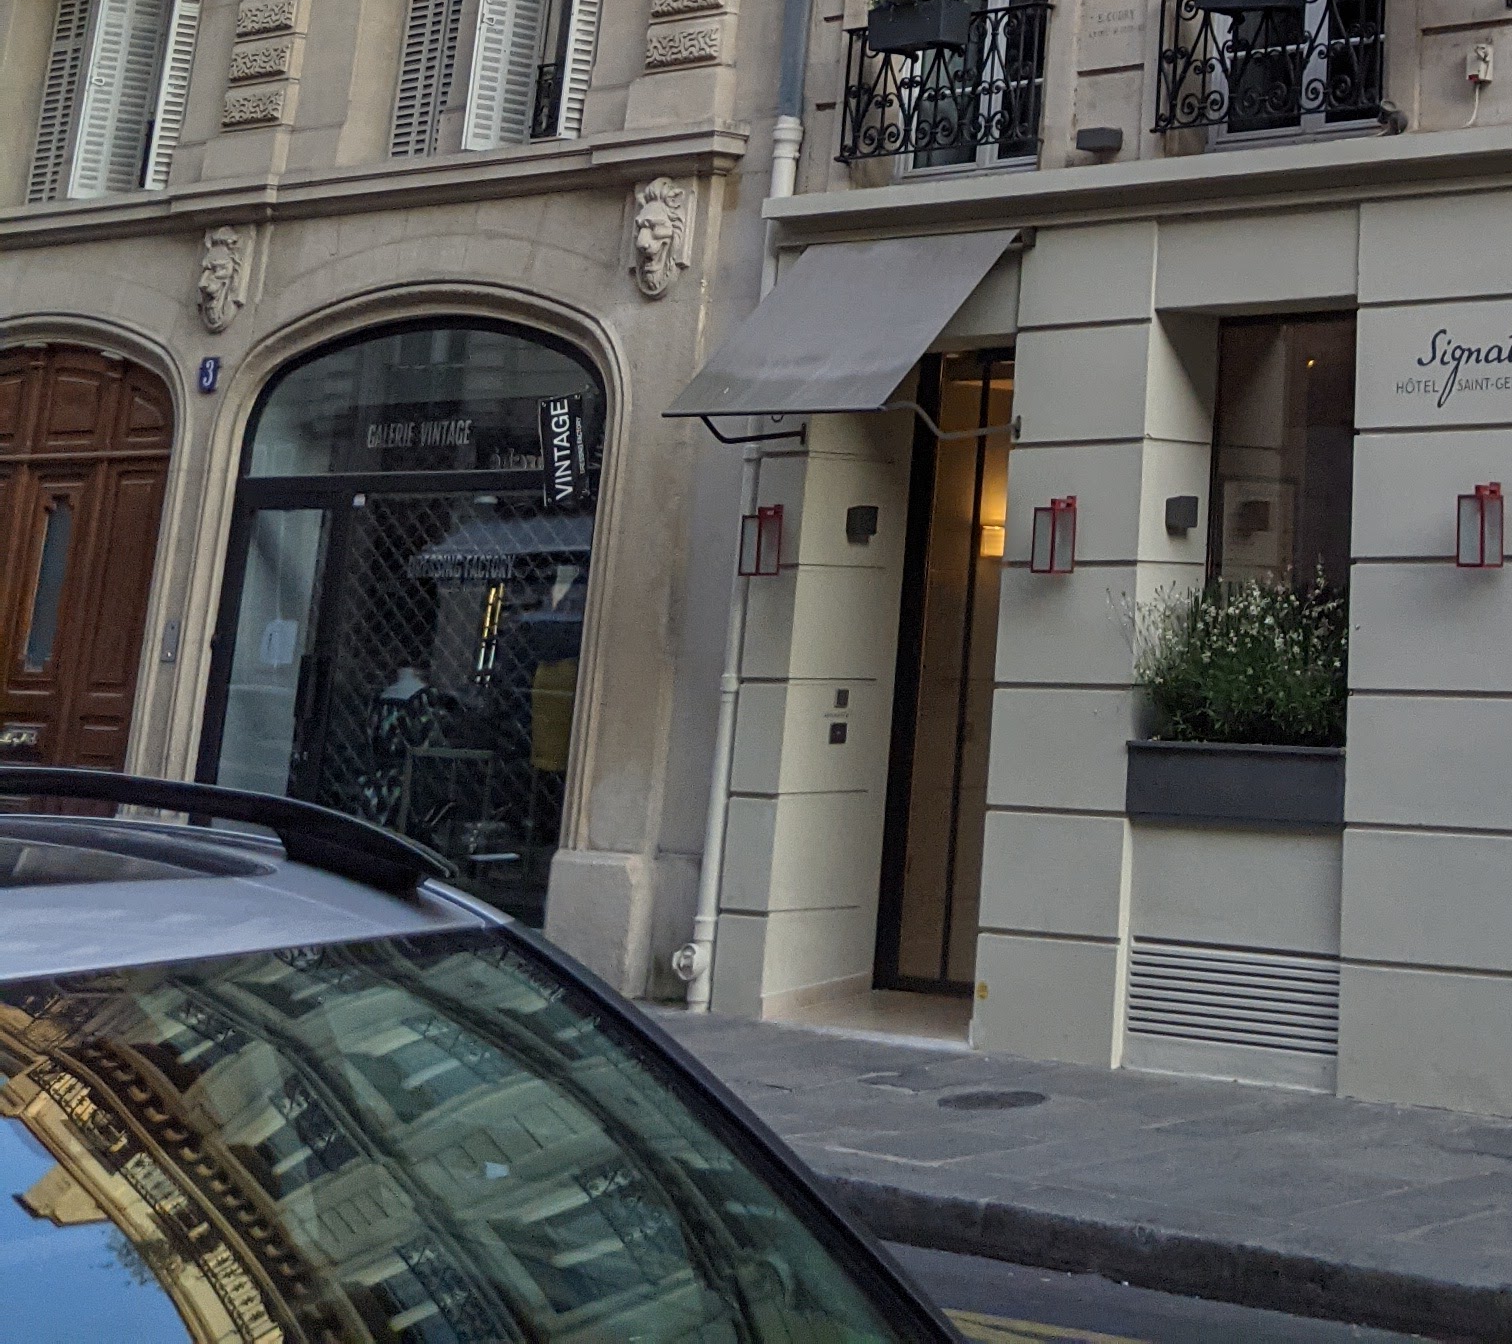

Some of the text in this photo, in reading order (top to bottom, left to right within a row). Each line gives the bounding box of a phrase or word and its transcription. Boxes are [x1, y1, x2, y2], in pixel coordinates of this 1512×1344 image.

[196, 360, 214, 386] 3
[1396, 378, 1439, 394] HÔTEL
[420, 419, 473, 447] VINTAGE
[550, 398, 573, 501] VINTAGE
